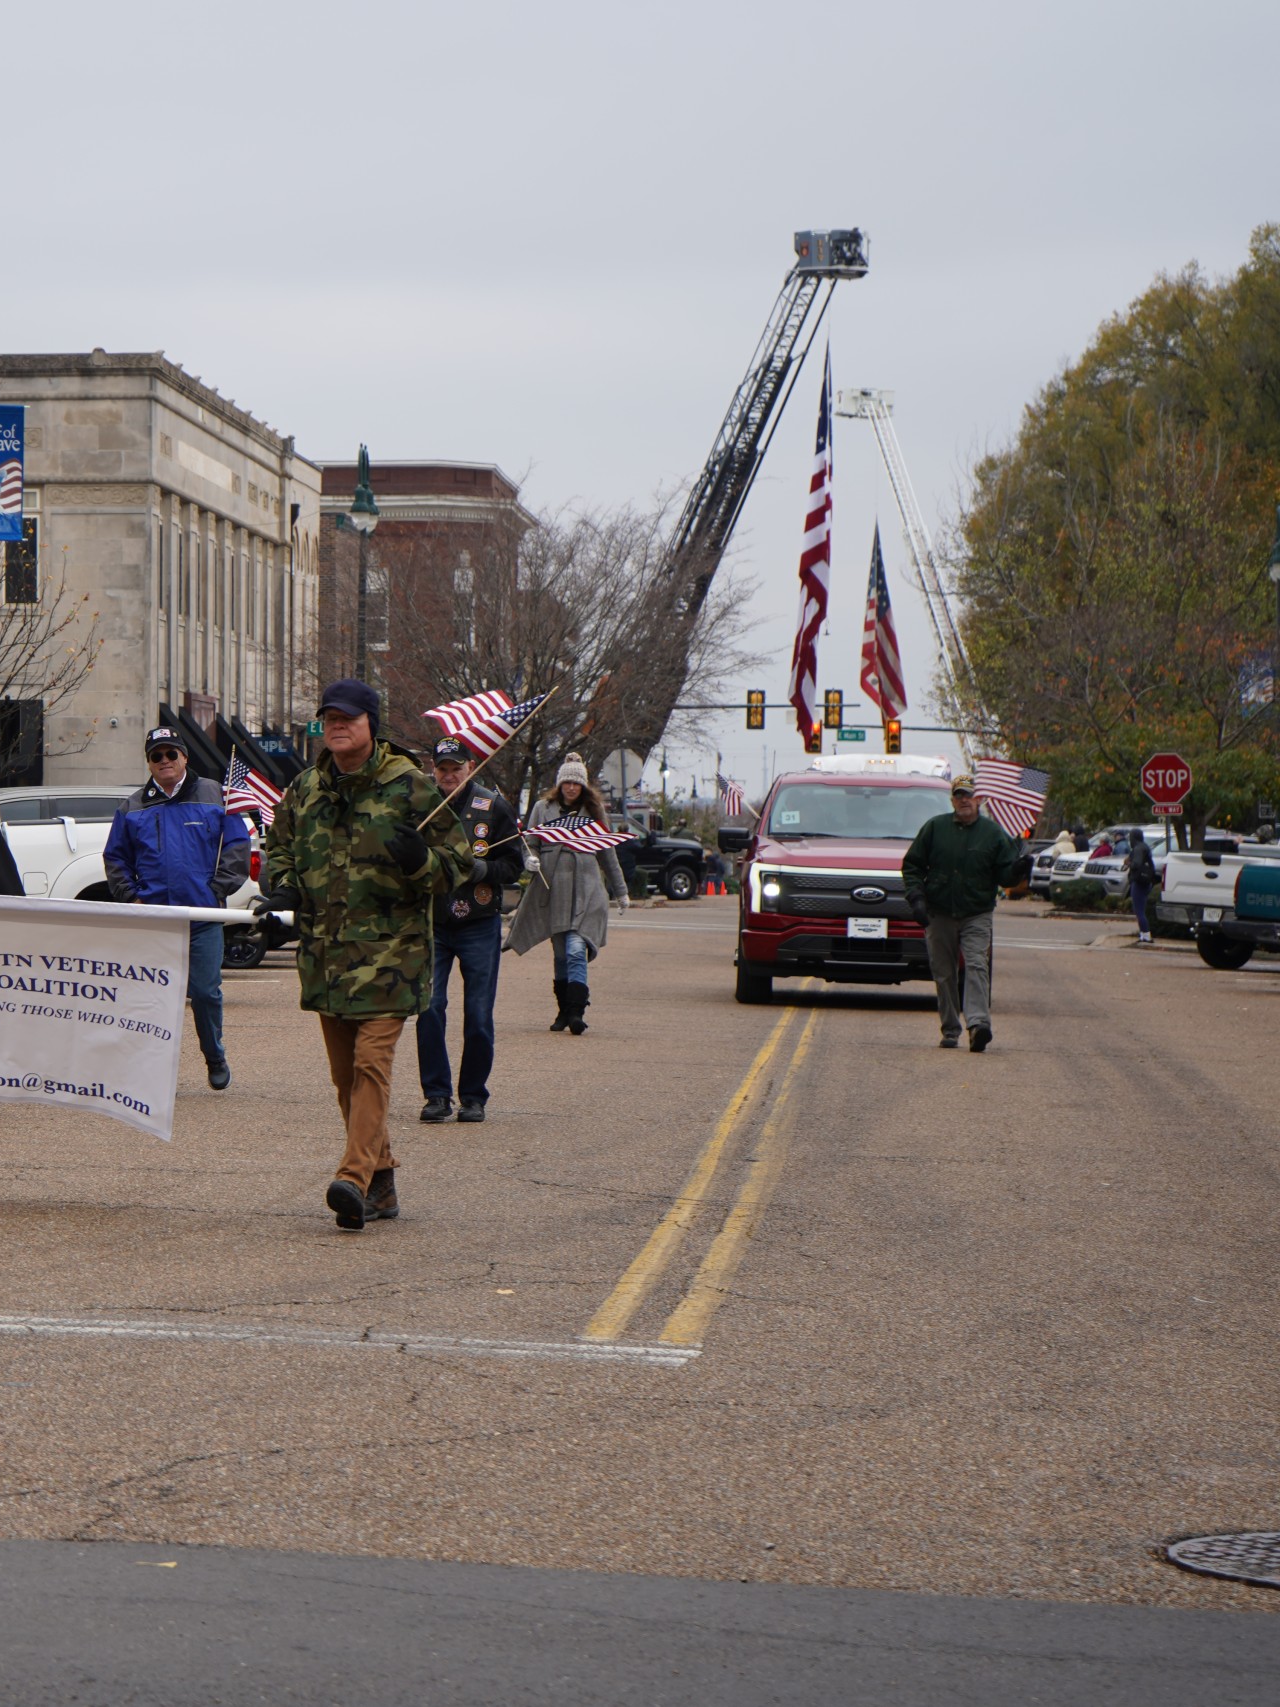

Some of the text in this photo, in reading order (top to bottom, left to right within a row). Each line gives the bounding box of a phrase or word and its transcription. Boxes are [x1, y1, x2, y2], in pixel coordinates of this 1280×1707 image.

[3, 423, 17, 439] of
[1145, 769, 1187, 788] STOP
[39, 955, 170, 987] VETERANS
[21, 1004, 73, 1020] THOSE
[77, 1010, 115, 1026] WHO
[118, 1018, 172, 1042] SERVED
